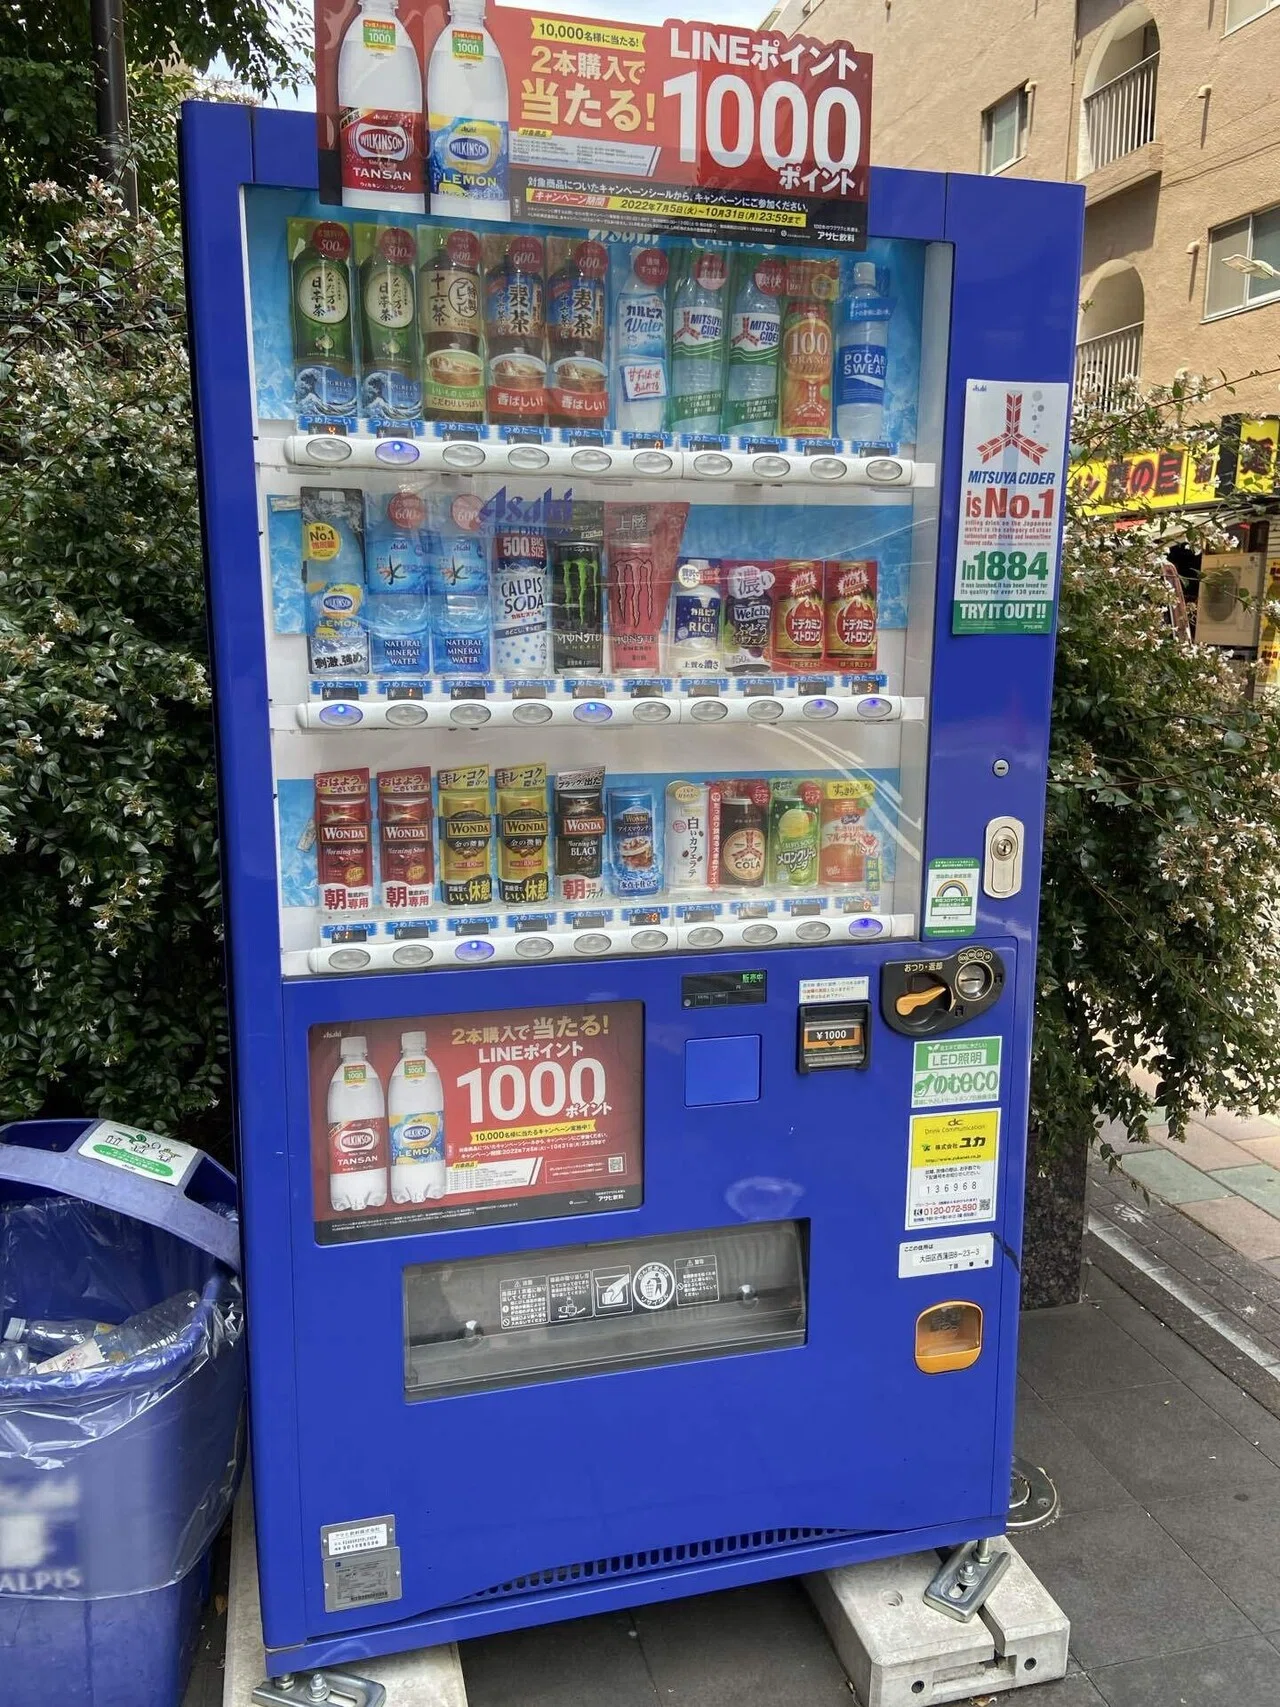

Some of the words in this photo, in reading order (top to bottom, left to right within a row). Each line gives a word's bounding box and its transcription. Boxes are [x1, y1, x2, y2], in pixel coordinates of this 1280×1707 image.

[539, 23, 639, 48] 10,000名様に当たる!
[669, 27, 858, 80] LINEポイント
[530, 45, 645, 85] 2本購入で
[520, 78, 655, 133] 当たる!
[662, 69, 860, 174] 1000
[358, 127, 405, 152] WILKINSON
[449, 138, 488, 157] WILKINSON
[352, 166, 412, 182] TANSAN
[442, 173, 497, 188] LEMON
[778, 163, 856, 196] ポイント
[535, 189, 606, 208] キャンペーン期間
[816, 231, 855, 243] アサヒ飲料
[430, 272, 450, 326] 十六茶
[508, 284, 530, 335] 麦茶
[572, 287, 594, 338] 麦茶
[626, 305, 663, 319] カルピス
[624, 317, 664, 334] Water
[790, 333, 827, 356] 100
[844, 363, 885, 375] SWEAT
[497, 391, 544, 409] 香ばしい!
[560, 394, 606, 412] 香ばしい!
[968, 470, 1017, 485] MITSUYA
[1019, 471, 1056, 486] CIDER
[477, 485, 573, 524] Asahi
[965, 490, 982, 518] is
[984, 488, 1055, 519] No.1
[615, 513, 648, 533] 上陸
[309, 530, 335, 542] No.1
[531, 546, 545, 558] SIZE
[961, 559, 976, 581] In
[973, 550, 1049, 581] 1884
[500, 576, 543, 599] CALPIS
[737, 568, 773, 595] 濃い
[842, 573, 864, 587] No.1
[504, 594, 545, 615] SODA
[735, 604, 770, 621] Welch's
[959, 603, 987, 619] TRY
[988, 603, 1003, 619] IT
[791, 618, 822, 631] ドデカミン
[842, 618, 874, 630] ドデカミン
[384, 639, 421, 648] NATURAL
[446, 639, 483, 647] NATURAL
[792, 631, 821, 643] ストロング
[843, 631, 873, 643] ストロング
[385, 649, 420, 657] MINERAL
[447, 648, 482, 656] MINERAL
[451, 656, 479, 664] WATER
[314, 653, 367, 670] 刺激、強め。
[390, 657, 418, 665] WATER
[317, 775, 361, 788] おはよう
[380, 774, 423, 787] おはよう
[323, 827, 365, 840] WONDA
[385, 826, 425, 839] WONDA
[450, 821, 489, 834] WONDA
[506, 820, 546, 832] WONDA
[566, 819, 601, 832] WONDA
[570, 847, 598, 857] BLACK
[686, 816, 700, 879] 白いカフェラテ
[735, 860, 761, 870] COLA
[386, 886, 408, 908] 朝
[562, 879, 586, 900] 朝
[324, 888, 347, 910] 朝
[347, 898, 369, 908] 専用
[408, 895, 429, 906] 専用
[904, 960, 943, 973] おつり・返却
[742, 973, 763, 983] 販売中
[451, 1024, 530, 1045] 2本購入で
[532, 1014, 609, 1040] 当たる!
[816, 1030, 847, 1041] ¥1000
[478, 1040, 584, 1064] LINEポイント
[932, 1051, 982, 1067] LED照明
[933, 1070, 998, 1094] のむeco
[456, 1057, 606, 1124] 1000
[565, 1101, 613, 1119] ポイント
[941, 1123, 986, 1132] Communication
[958, 1136, 986, 1149] ユカ
[398, 1147, 437, 1157] LEMON
[337, 1155, 378, 1166] TANSAN
[923, 1203, 978, 1216] 0120-072-590
